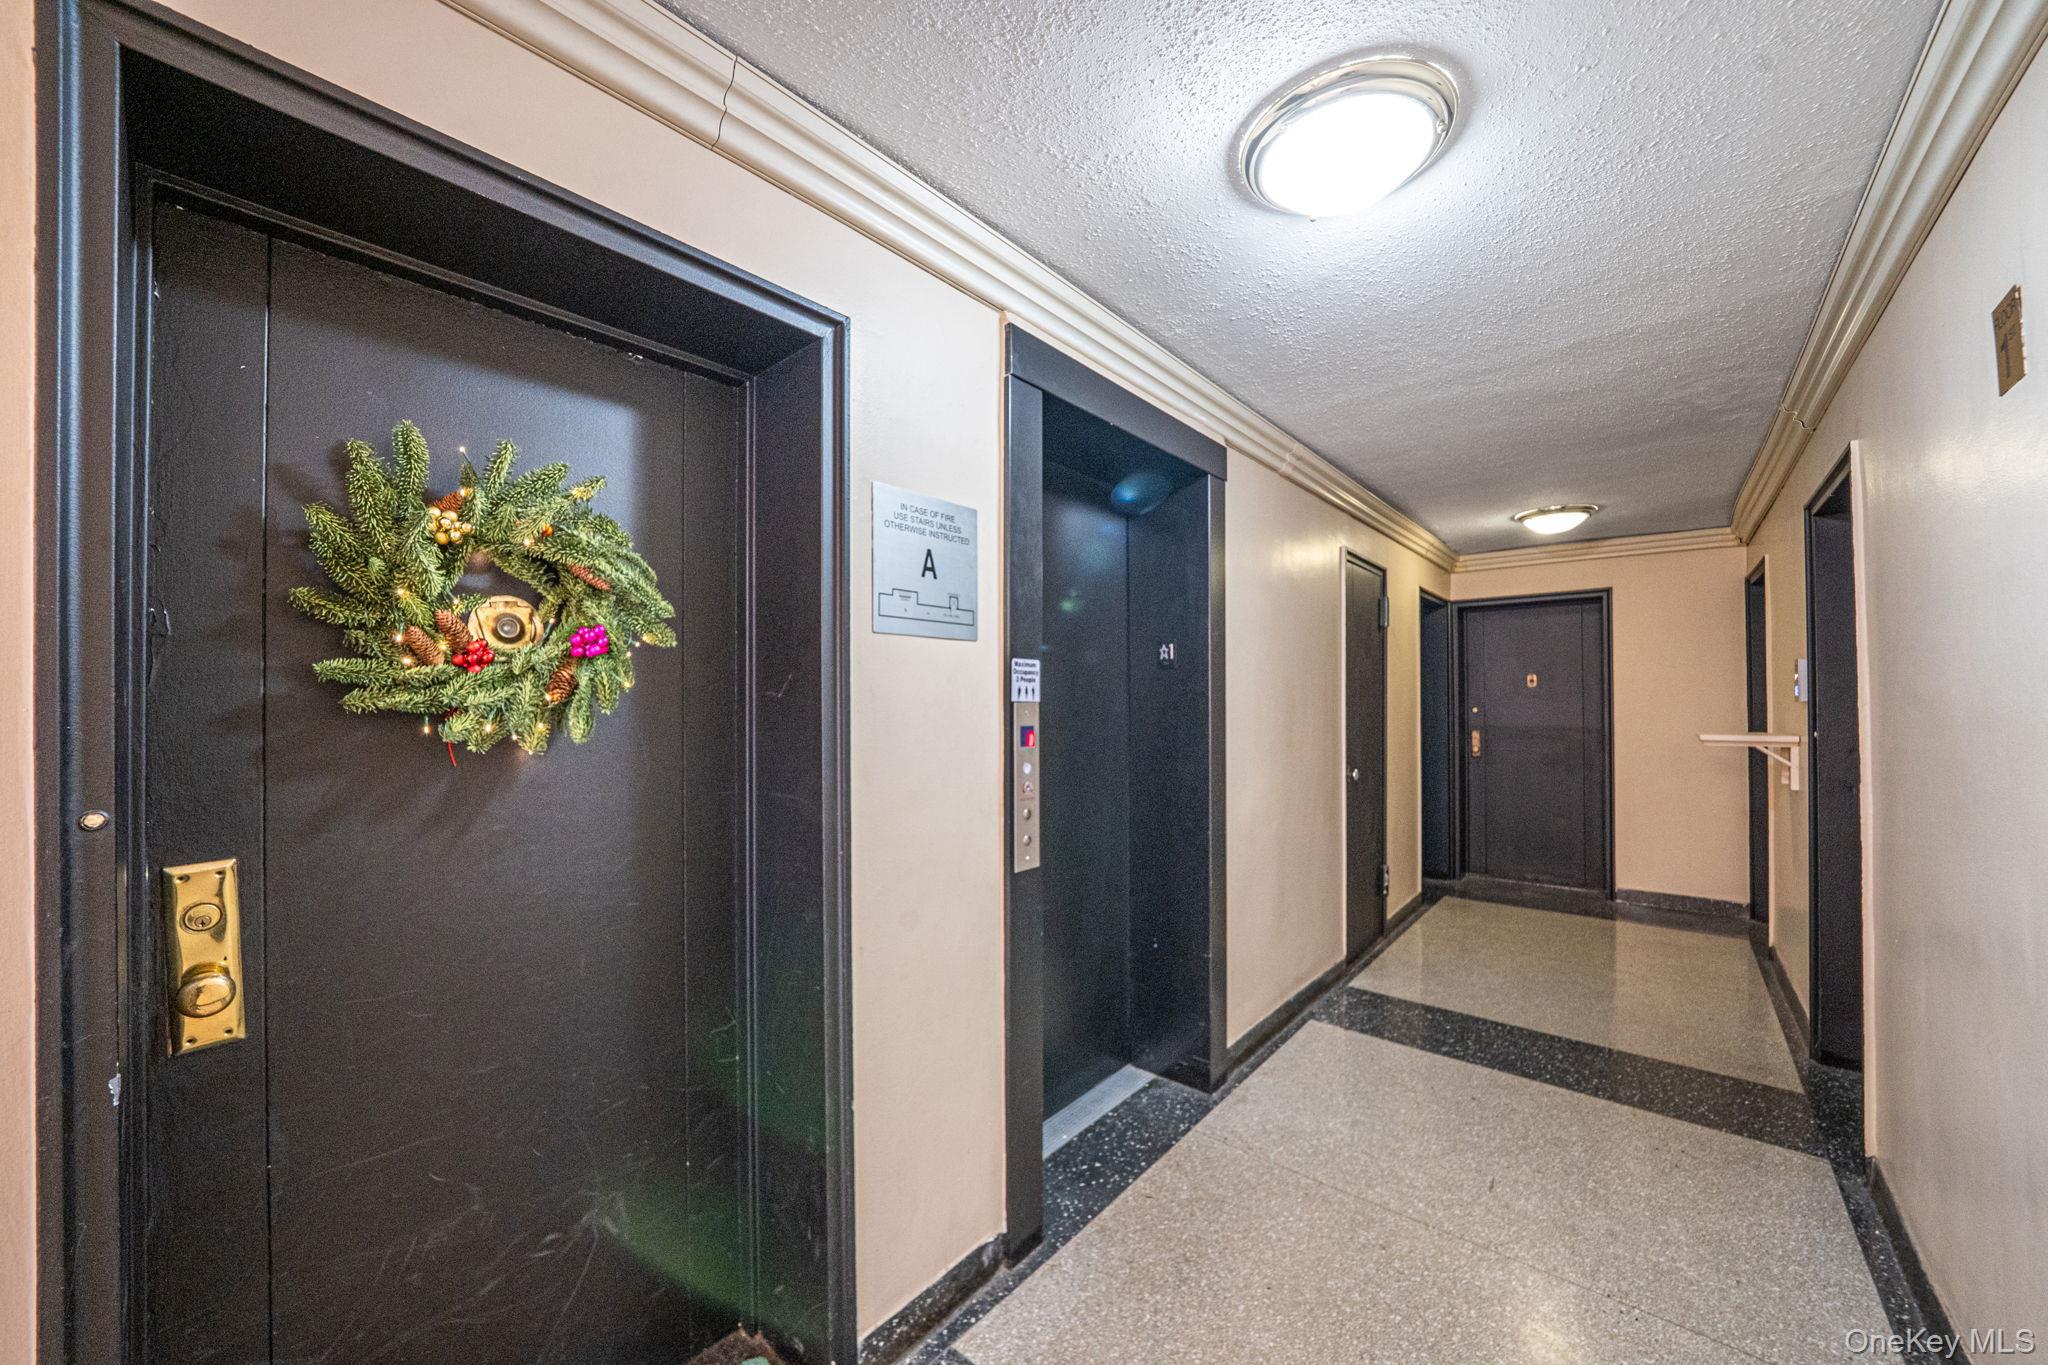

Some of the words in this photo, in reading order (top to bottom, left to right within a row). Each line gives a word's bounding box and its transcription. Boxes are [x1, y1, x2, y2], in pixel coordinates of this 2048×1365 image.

[893, 512, 908, 521] USE
[910, 515, 935, 528] STAIRS
[936, 522, 962, 534] UNLESS
[900, 503, 908, 511] IN
[909, 505, 928, 516] CASE
[930, 510, 939, 519] OF
[941, 513, 956, 524] FIRE
[884, 519, 927, 536] OTHERWISE
[928, 530, 970, 546] INSTRUCTED
[921, 548, 938, 580] A
